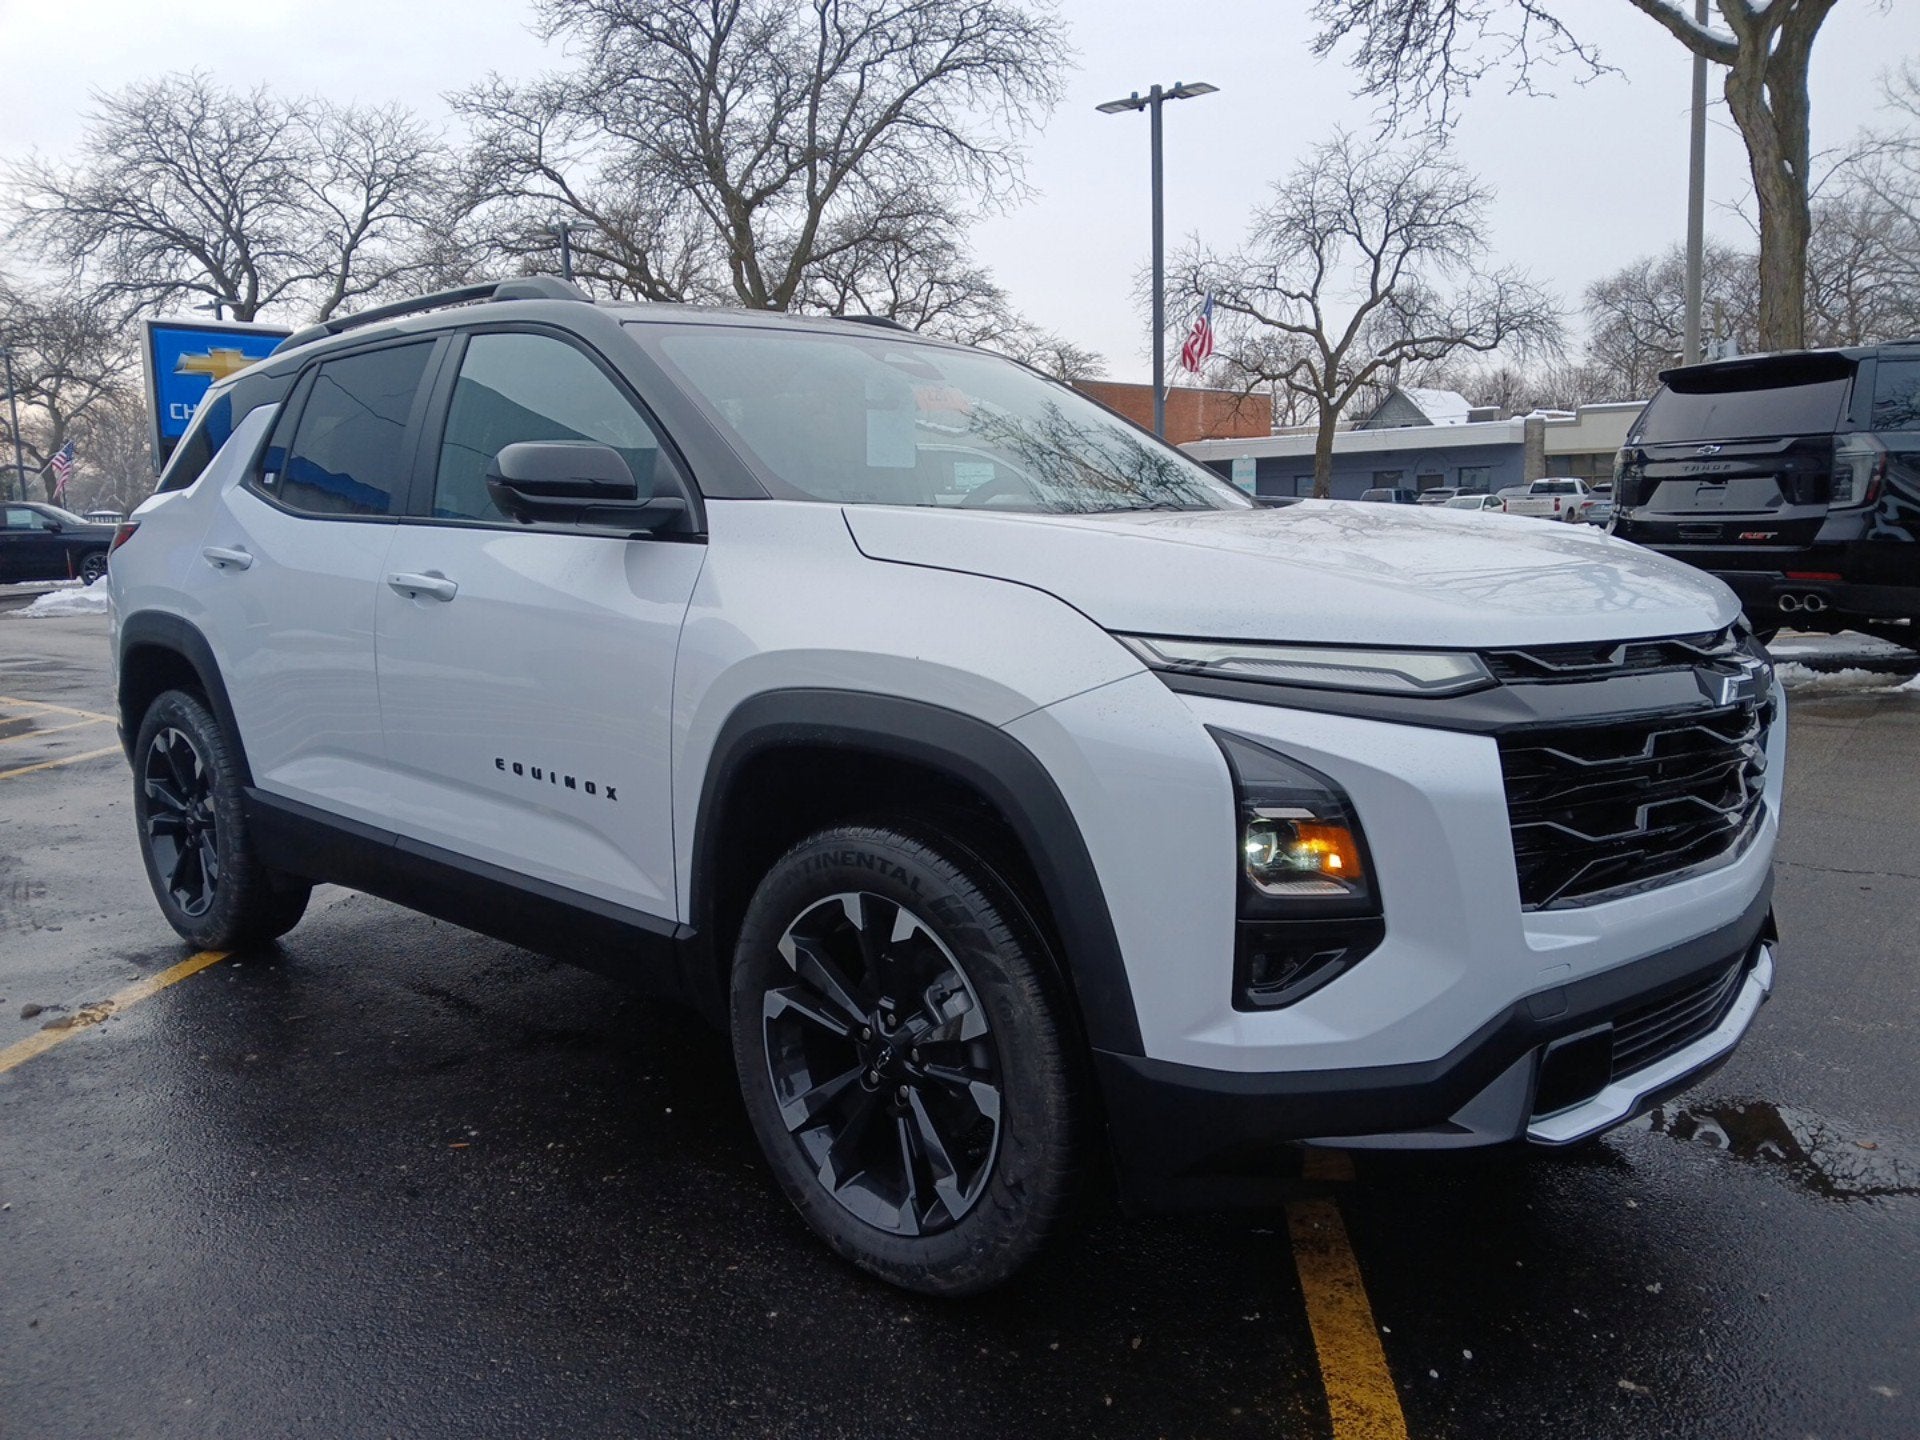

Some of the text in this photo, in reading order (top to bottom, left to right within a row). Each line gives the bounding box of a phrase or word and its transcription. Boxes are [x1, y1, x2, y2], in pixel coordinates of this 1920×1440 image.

[1682, 464, 1731, 472] TAHOE
[495, 757, 618, 801] EQUINOX
[770, 851, 924, 898] NTINENTAL
